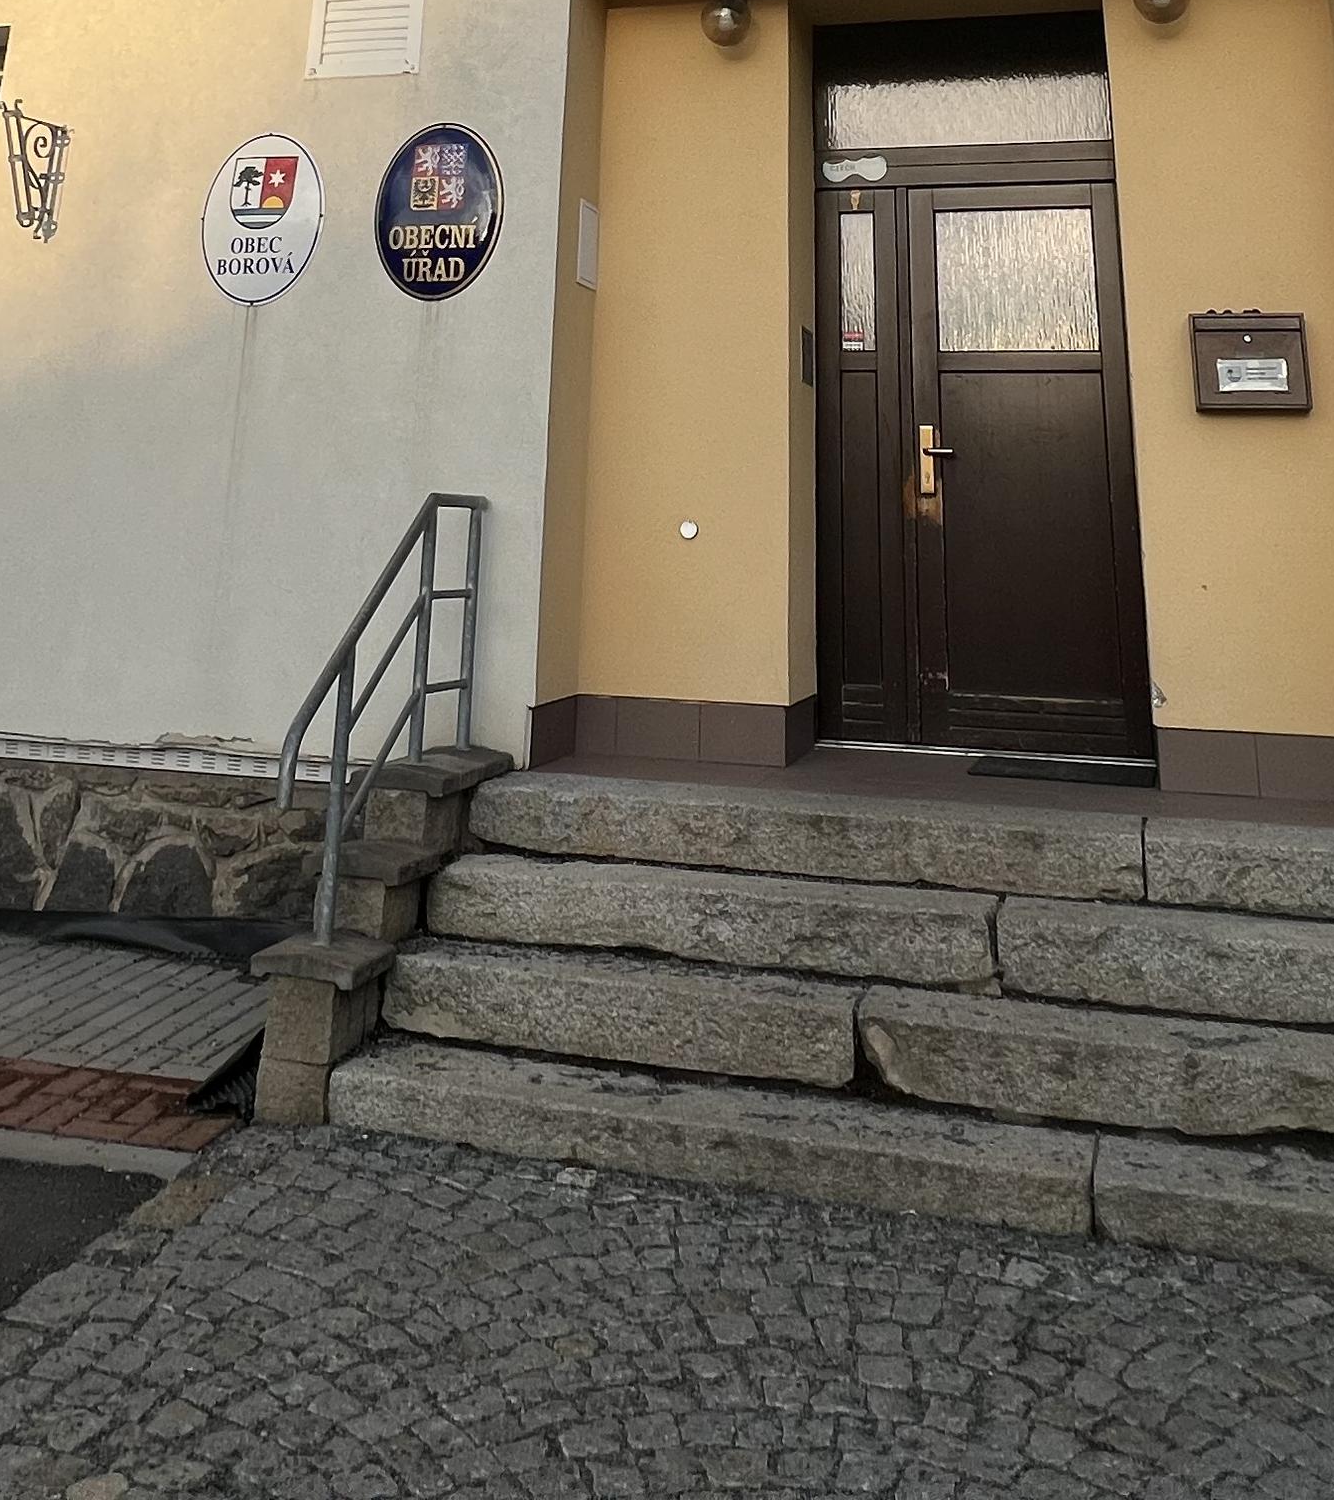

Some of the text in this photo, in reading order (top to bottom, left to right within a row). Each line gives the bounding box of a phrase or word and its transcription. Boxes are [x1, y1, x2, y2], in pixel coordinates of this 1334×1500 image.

[230, 236, 283, 254] OBEC
[388, 217, 478, 249] OBECNÍ
[216, 252, 295, 276] BOROVÁ
[402, 250, 465, 282] ÚŘAD
